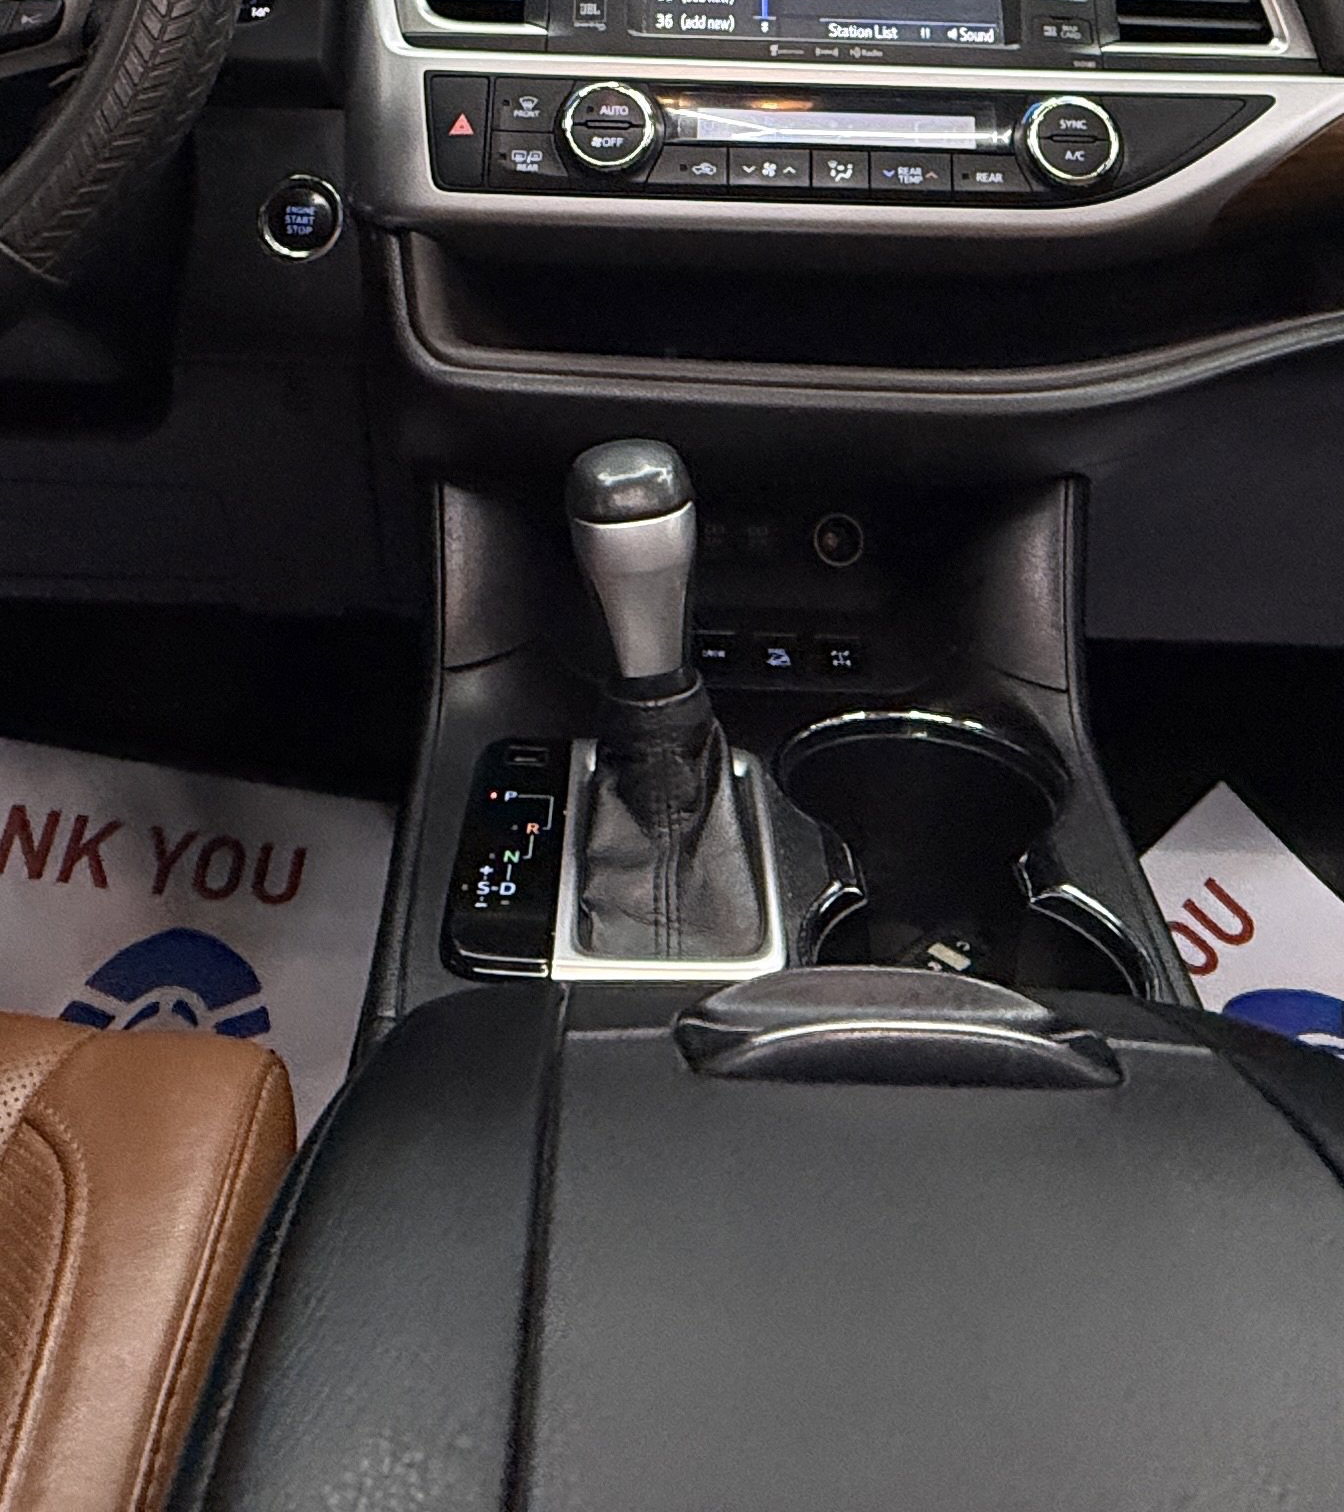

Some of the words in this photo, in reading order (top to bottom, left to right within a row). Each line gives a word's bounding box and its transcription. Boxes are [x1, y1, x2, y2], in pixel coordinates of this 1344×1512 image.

[580, 3, 601, 16] JBL
[655, 13, 674, 29] 36
[680, 13, 707, 30] (add
[707, 15, 735, 32] new)
[828, 23, 873, 38] Station
[874, 25, 898, 39] List
[960, 28, 994, 43] Sound
[513, 109, 540, 118] FRONT
[600, 105, 628, 115] AUTO
[1059, 119, 1088, 131] SYNC
[602, 136, 624, 148] OFF
[1064, 150, 1086, 162] A/C
[516, 162, 538, 171] REAR
[897, 167, 921, 176] REAR
[899, 175, 923, 184] TEMP
[976, 172, 1004, 184] REAR
[286, 206, 316, 215] ENGINE
[285, 215, 315, 225] START
[286, 225, 313, 234] STOP
[504, 791, 518, 801] P
[526, 822, 540, 834] R
[503, 850, 520, 863] N
[148, 824, 308, 906] YOU
